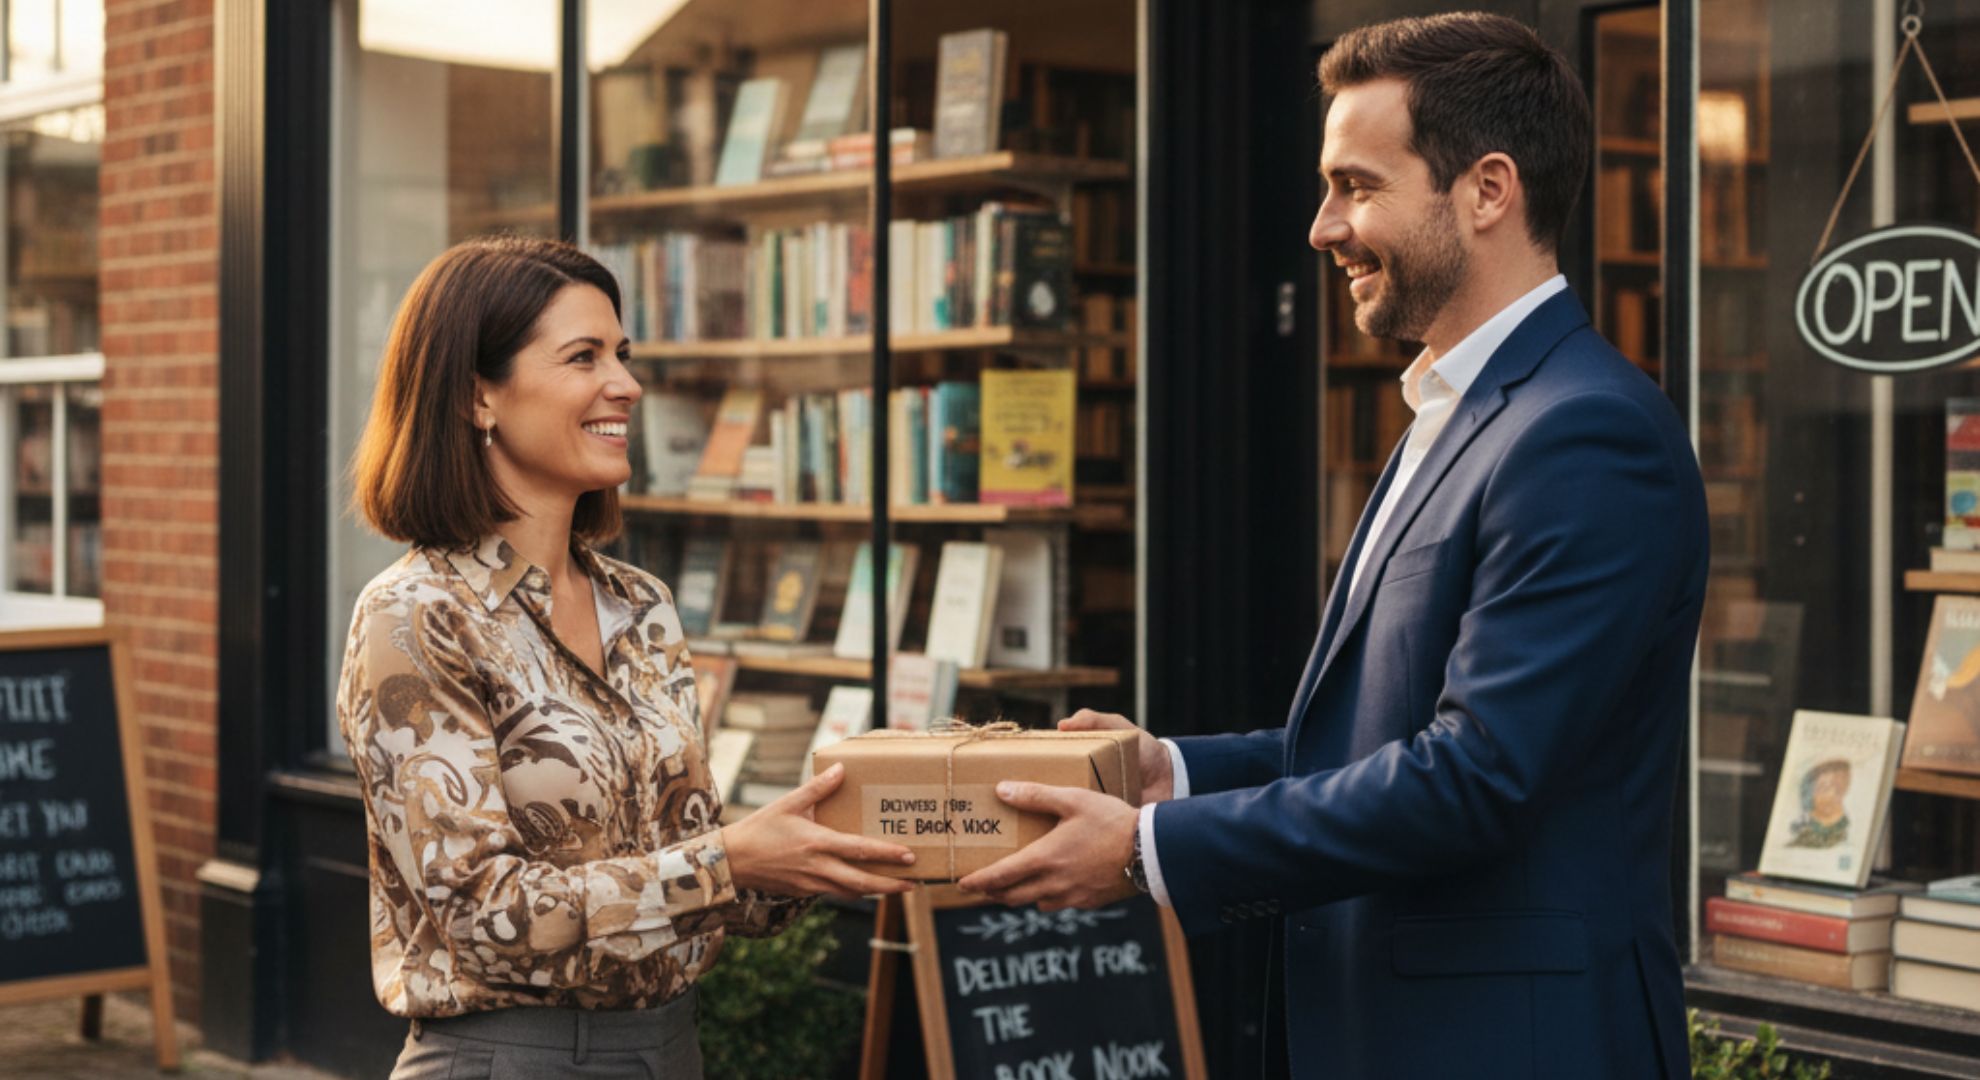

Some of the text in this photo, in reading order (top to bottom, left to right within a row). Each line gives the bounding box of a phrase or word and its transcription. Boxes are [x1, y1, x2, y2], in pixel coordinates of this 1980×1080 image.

[1815, 259, 1980, 345] OPEN
[953, 946, 1081, 997] DELIVERY
[972, 1003, 1035, 1045] THE
[1092, 1038, 1171, 1080] NOOK
